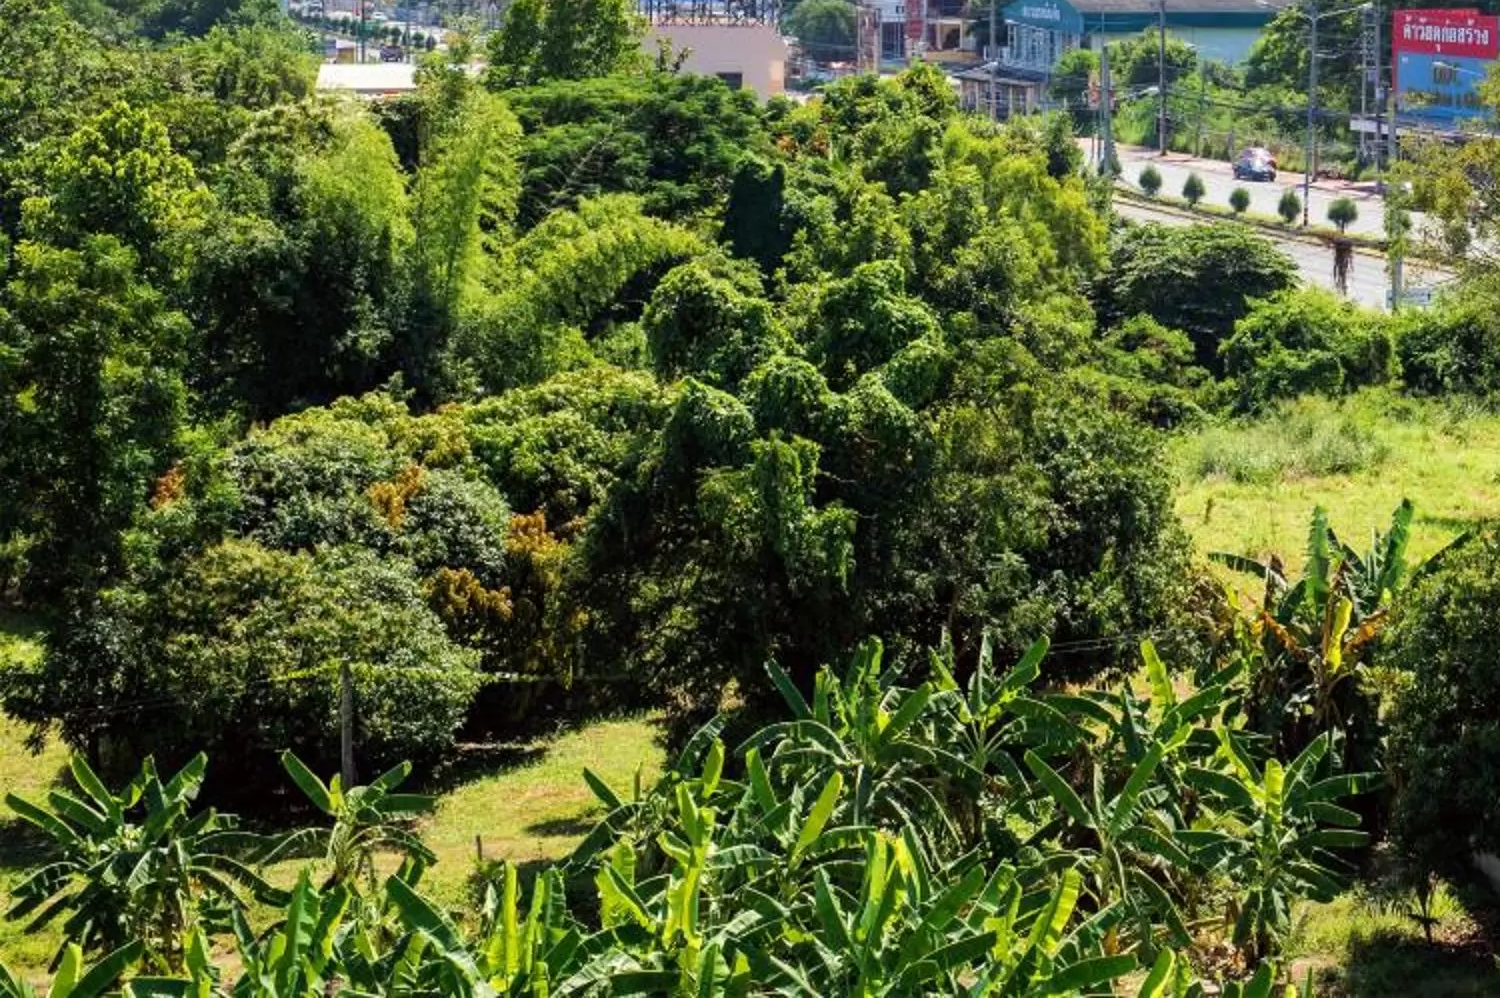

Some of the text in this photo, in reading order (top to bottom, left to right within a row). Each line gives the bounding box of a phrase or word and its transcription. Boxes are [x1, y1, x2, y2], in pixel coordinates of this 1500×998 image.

[1403, 14, 1490, 53] ค้าวัสดุก่อสร้าง
